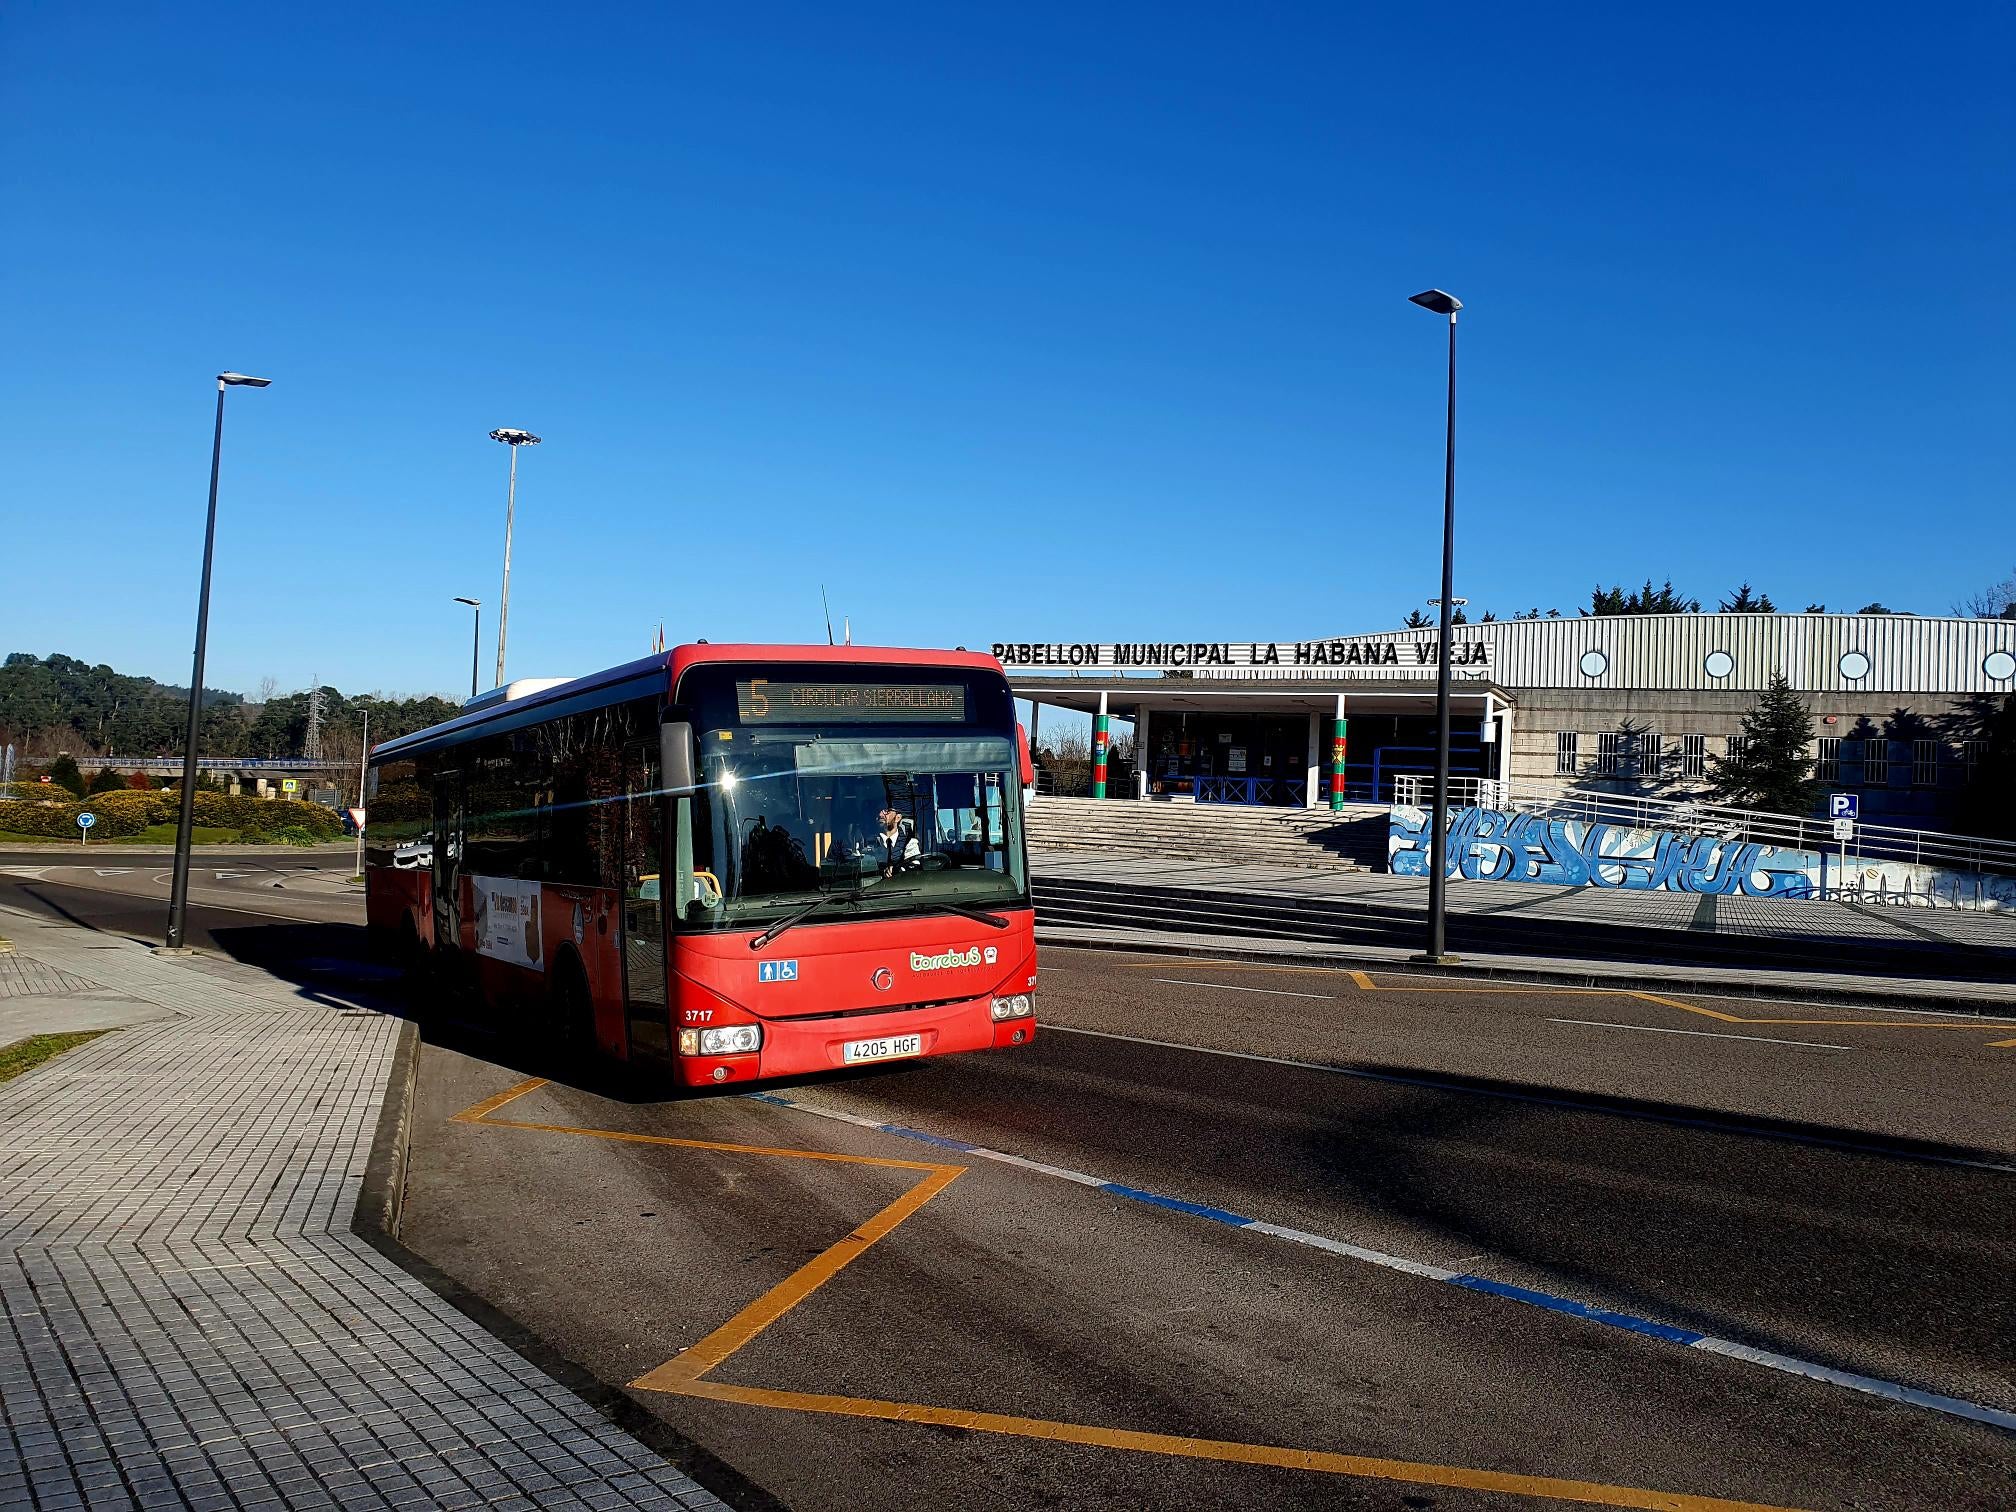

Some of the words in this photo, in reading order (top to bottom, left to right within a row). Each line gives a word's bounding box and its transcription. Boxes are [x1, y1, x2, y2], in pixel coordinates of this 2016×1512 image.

[991, 643, 1100, 665] PABELLON
[1113, 643, 1235, 665] MUNICIPAL
[1250, 642, 1279, 665] LA
[1294, 642, 1399, 665] HABANA
[791, 688, 859, 707] CIRCULAR
[1833, 796, 1850, 815] P
[685, 1010, 713, 1022] 3717
[853, 1041, 888, 1058] 4205
[893, 1037, 918, 1054] HGF
